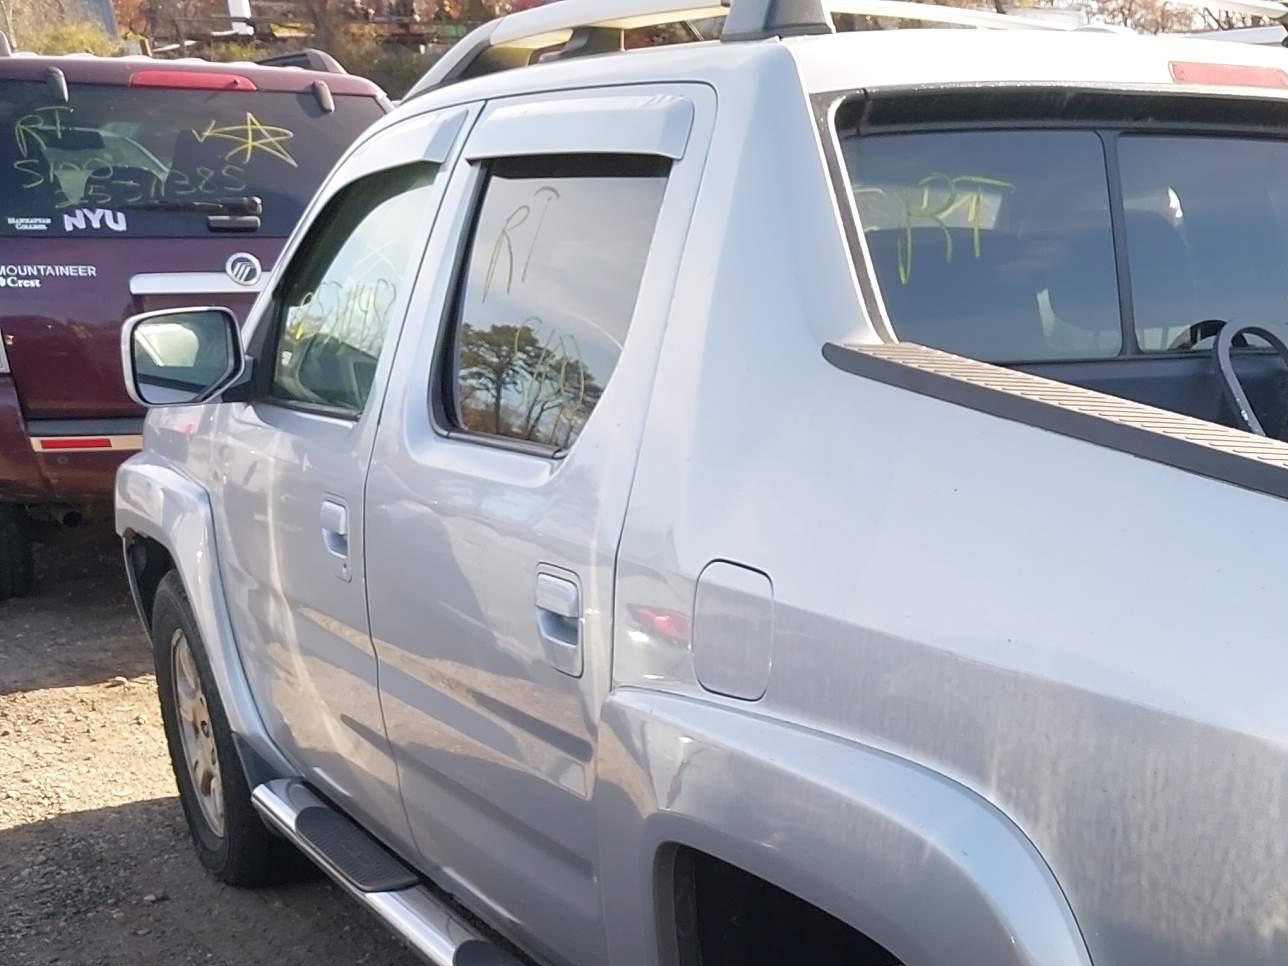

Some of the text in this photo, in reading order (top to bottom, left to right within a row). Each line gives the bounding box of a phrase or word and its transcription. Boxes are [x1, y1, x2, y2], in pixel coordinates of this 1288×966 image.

[63, 208, 128, 232] NYU
[0, 264, 98, 277] MOUNTAINEER
[7, 276, 41, 288] Crest
